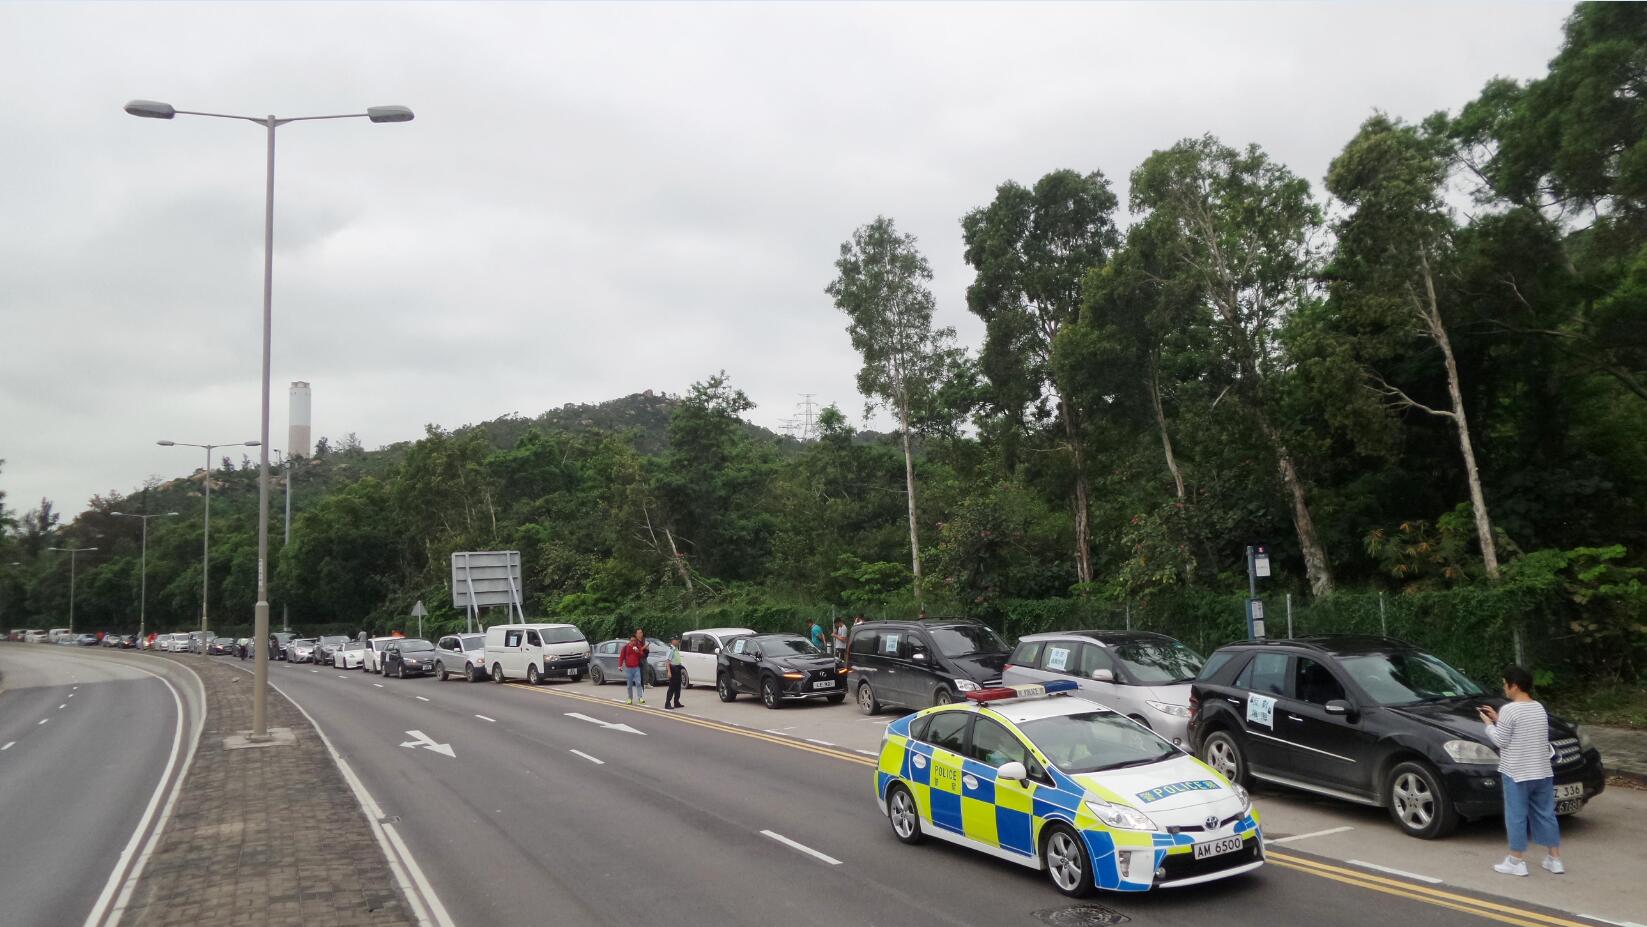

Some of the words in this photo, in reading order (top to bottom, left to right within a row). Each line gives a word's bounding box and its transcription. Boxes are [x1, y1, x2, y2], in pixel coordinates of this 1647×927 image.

[934, 765, 957, 781] POLICE
[1153, 780, 1208, 798] POLICE
[1564, 784, 1581, 797] 336
[1197, 844, 1212, 858] AM
[1215, 837, 1241, 854] 6500
